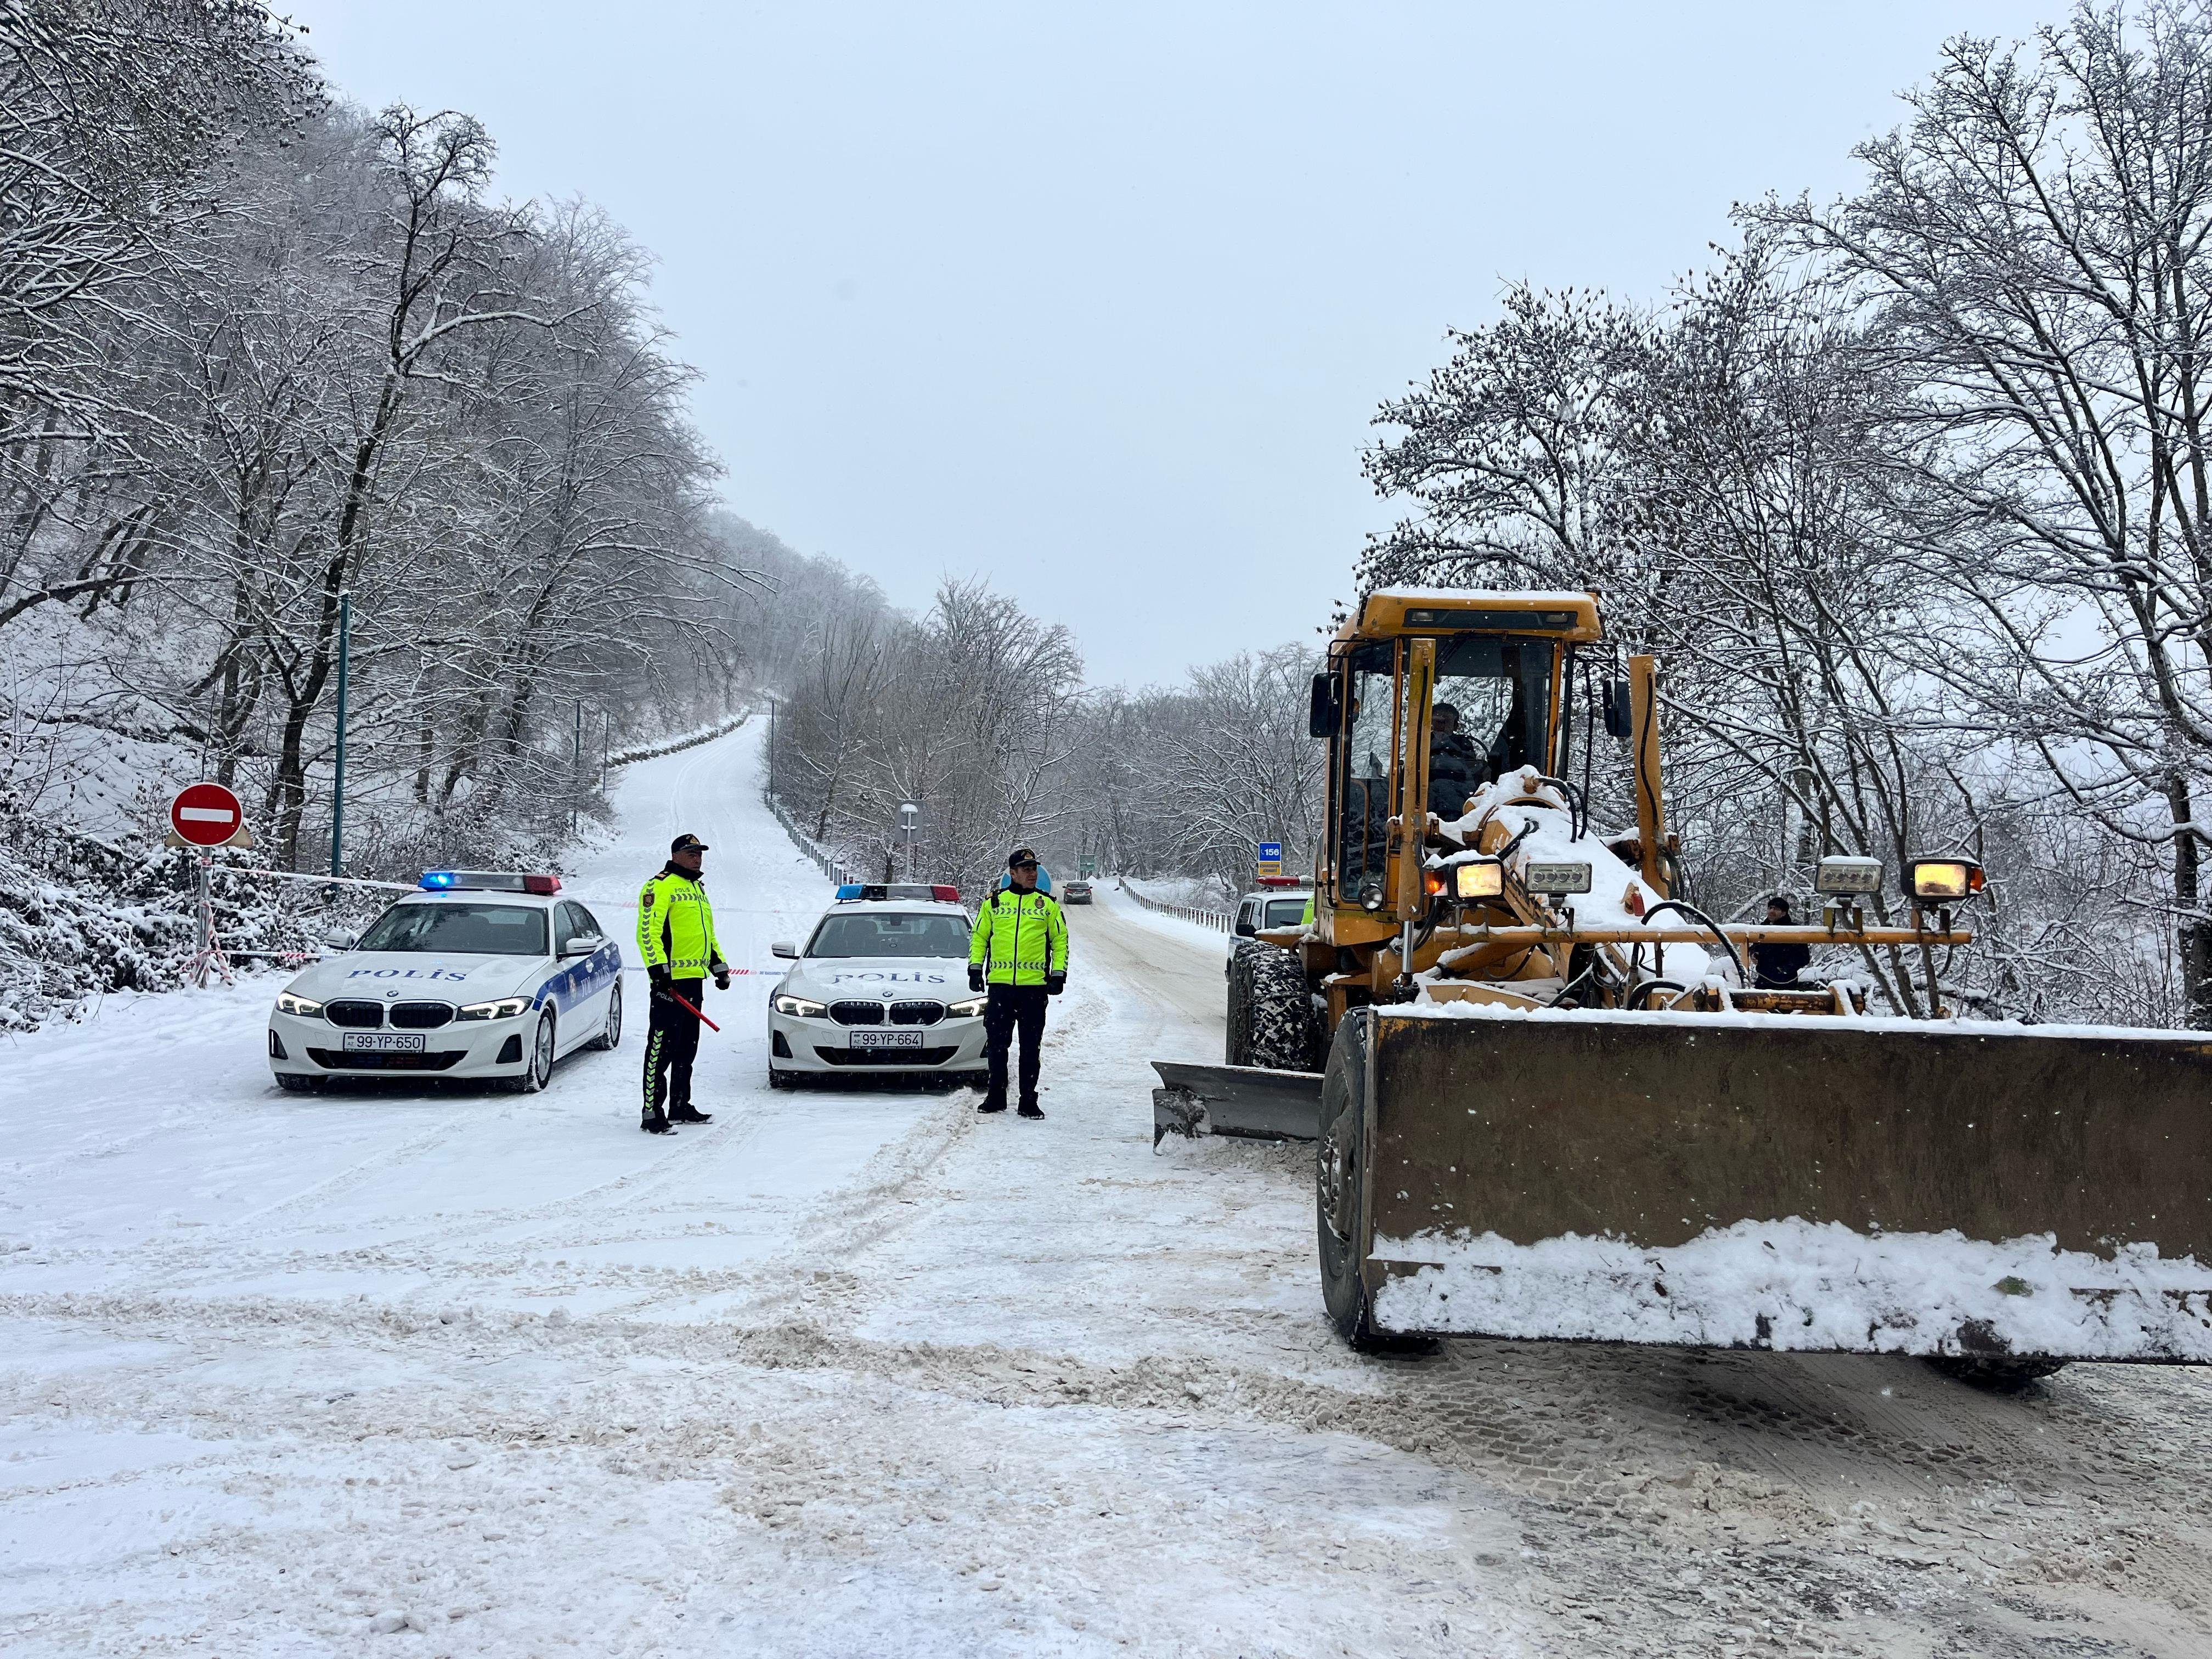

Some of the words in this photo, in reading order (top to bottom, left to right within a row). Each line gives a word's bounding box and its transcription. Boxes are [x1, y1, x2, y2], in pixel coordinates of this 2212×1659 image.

[345, 969, 467, 981] POLİS
[831, 972, 945, 984] POLİS
[357, 1036, 420, 1048] 99-YP-650
[862, 1034, 919, 1045] 99-YP-664
